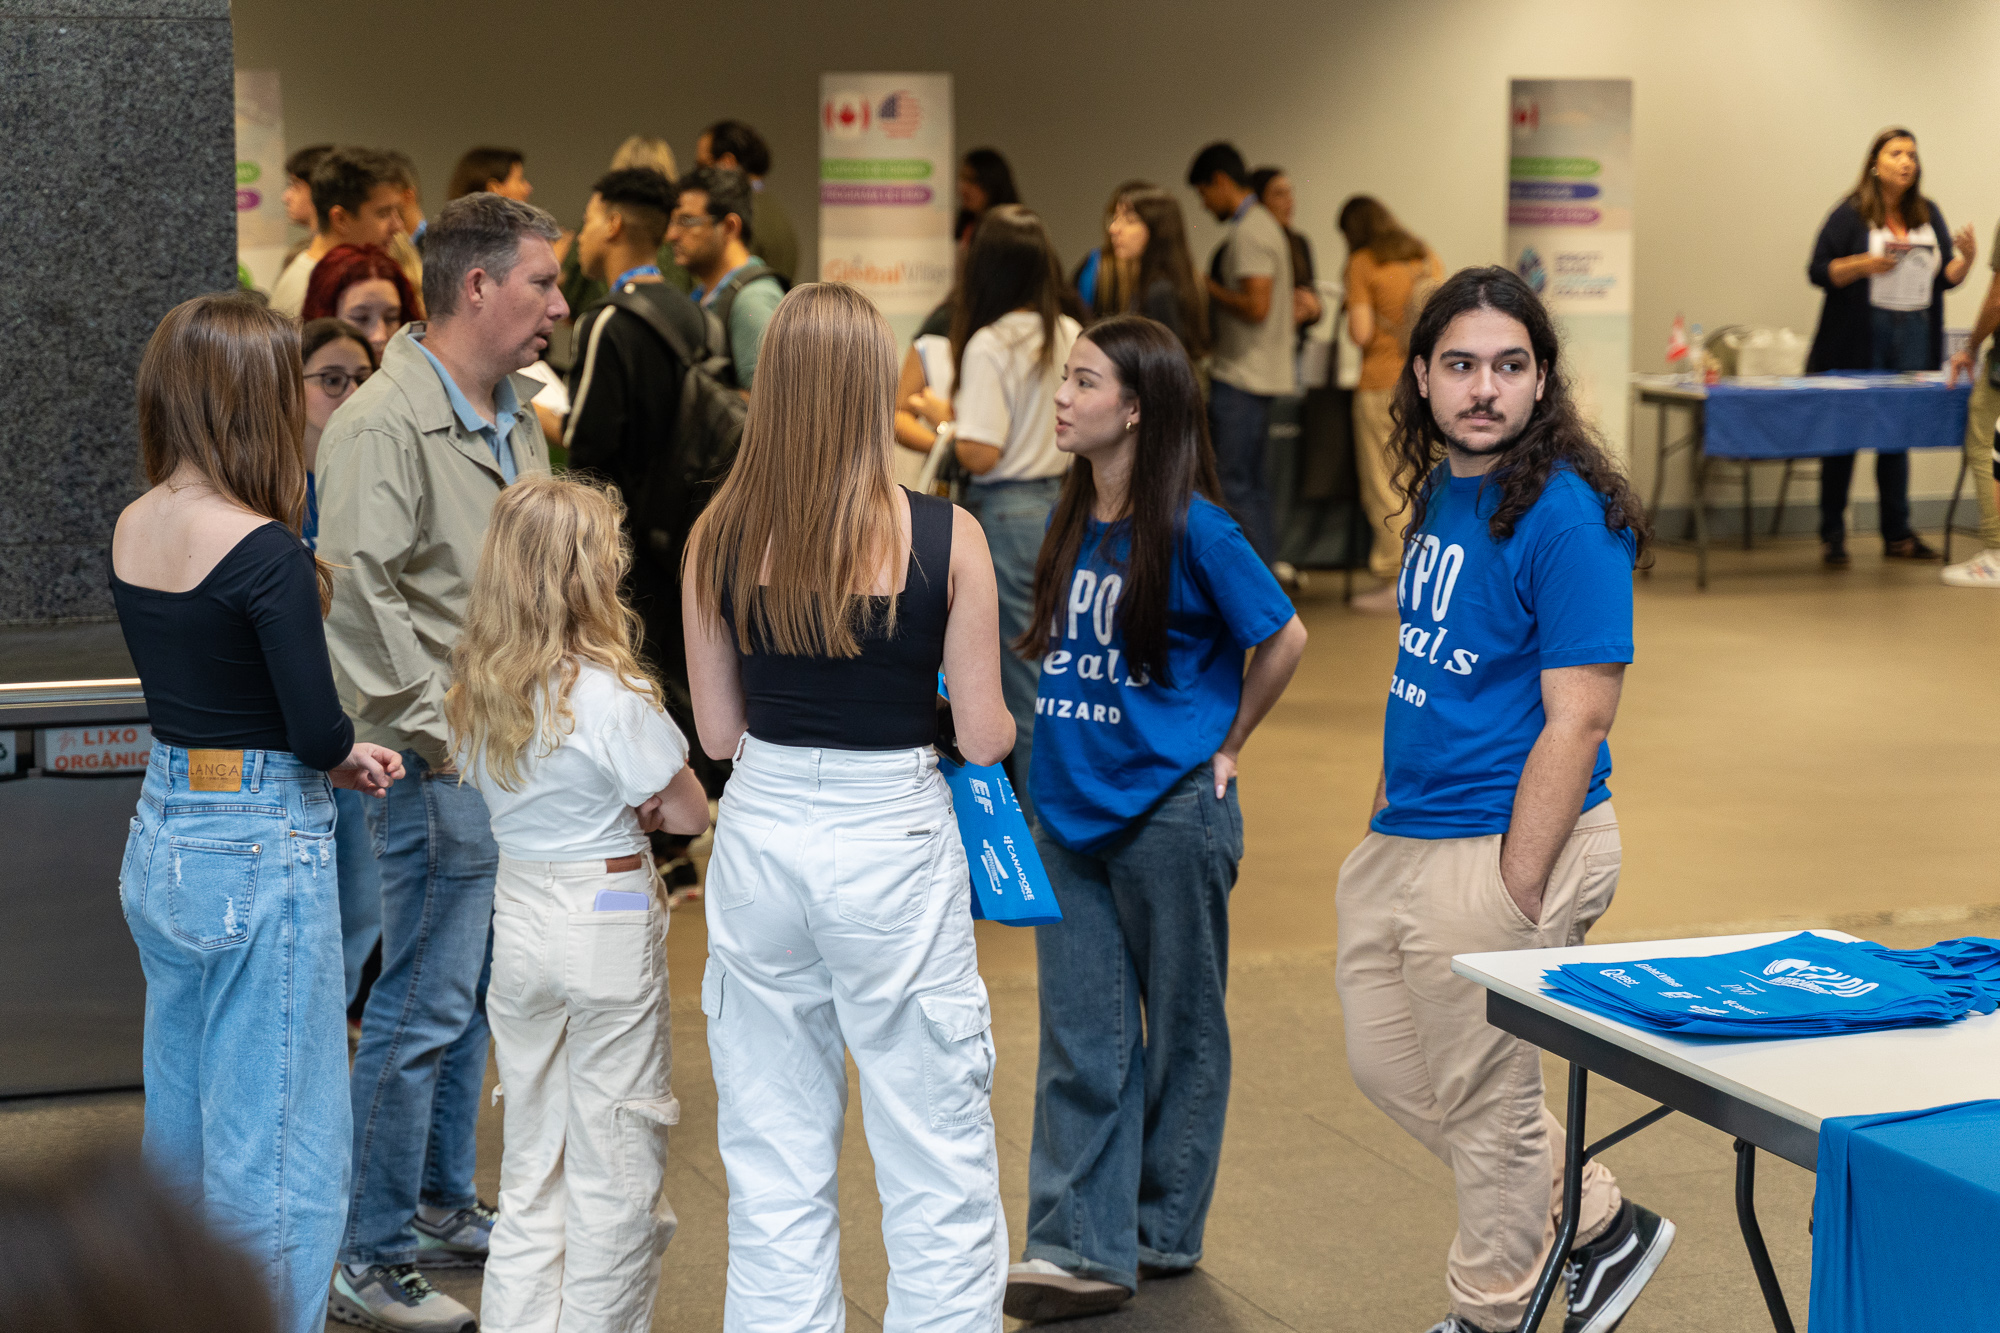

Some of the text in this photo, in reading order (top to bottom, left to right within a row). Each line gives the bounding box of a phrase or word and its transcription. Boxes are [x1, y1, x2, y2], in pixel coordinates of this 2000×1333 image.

[83, 728, 138, 746] LIXO
[55, 750, 151, 771] ORGÂNIC
[1007, 844, 1036, 901] CANADORE
